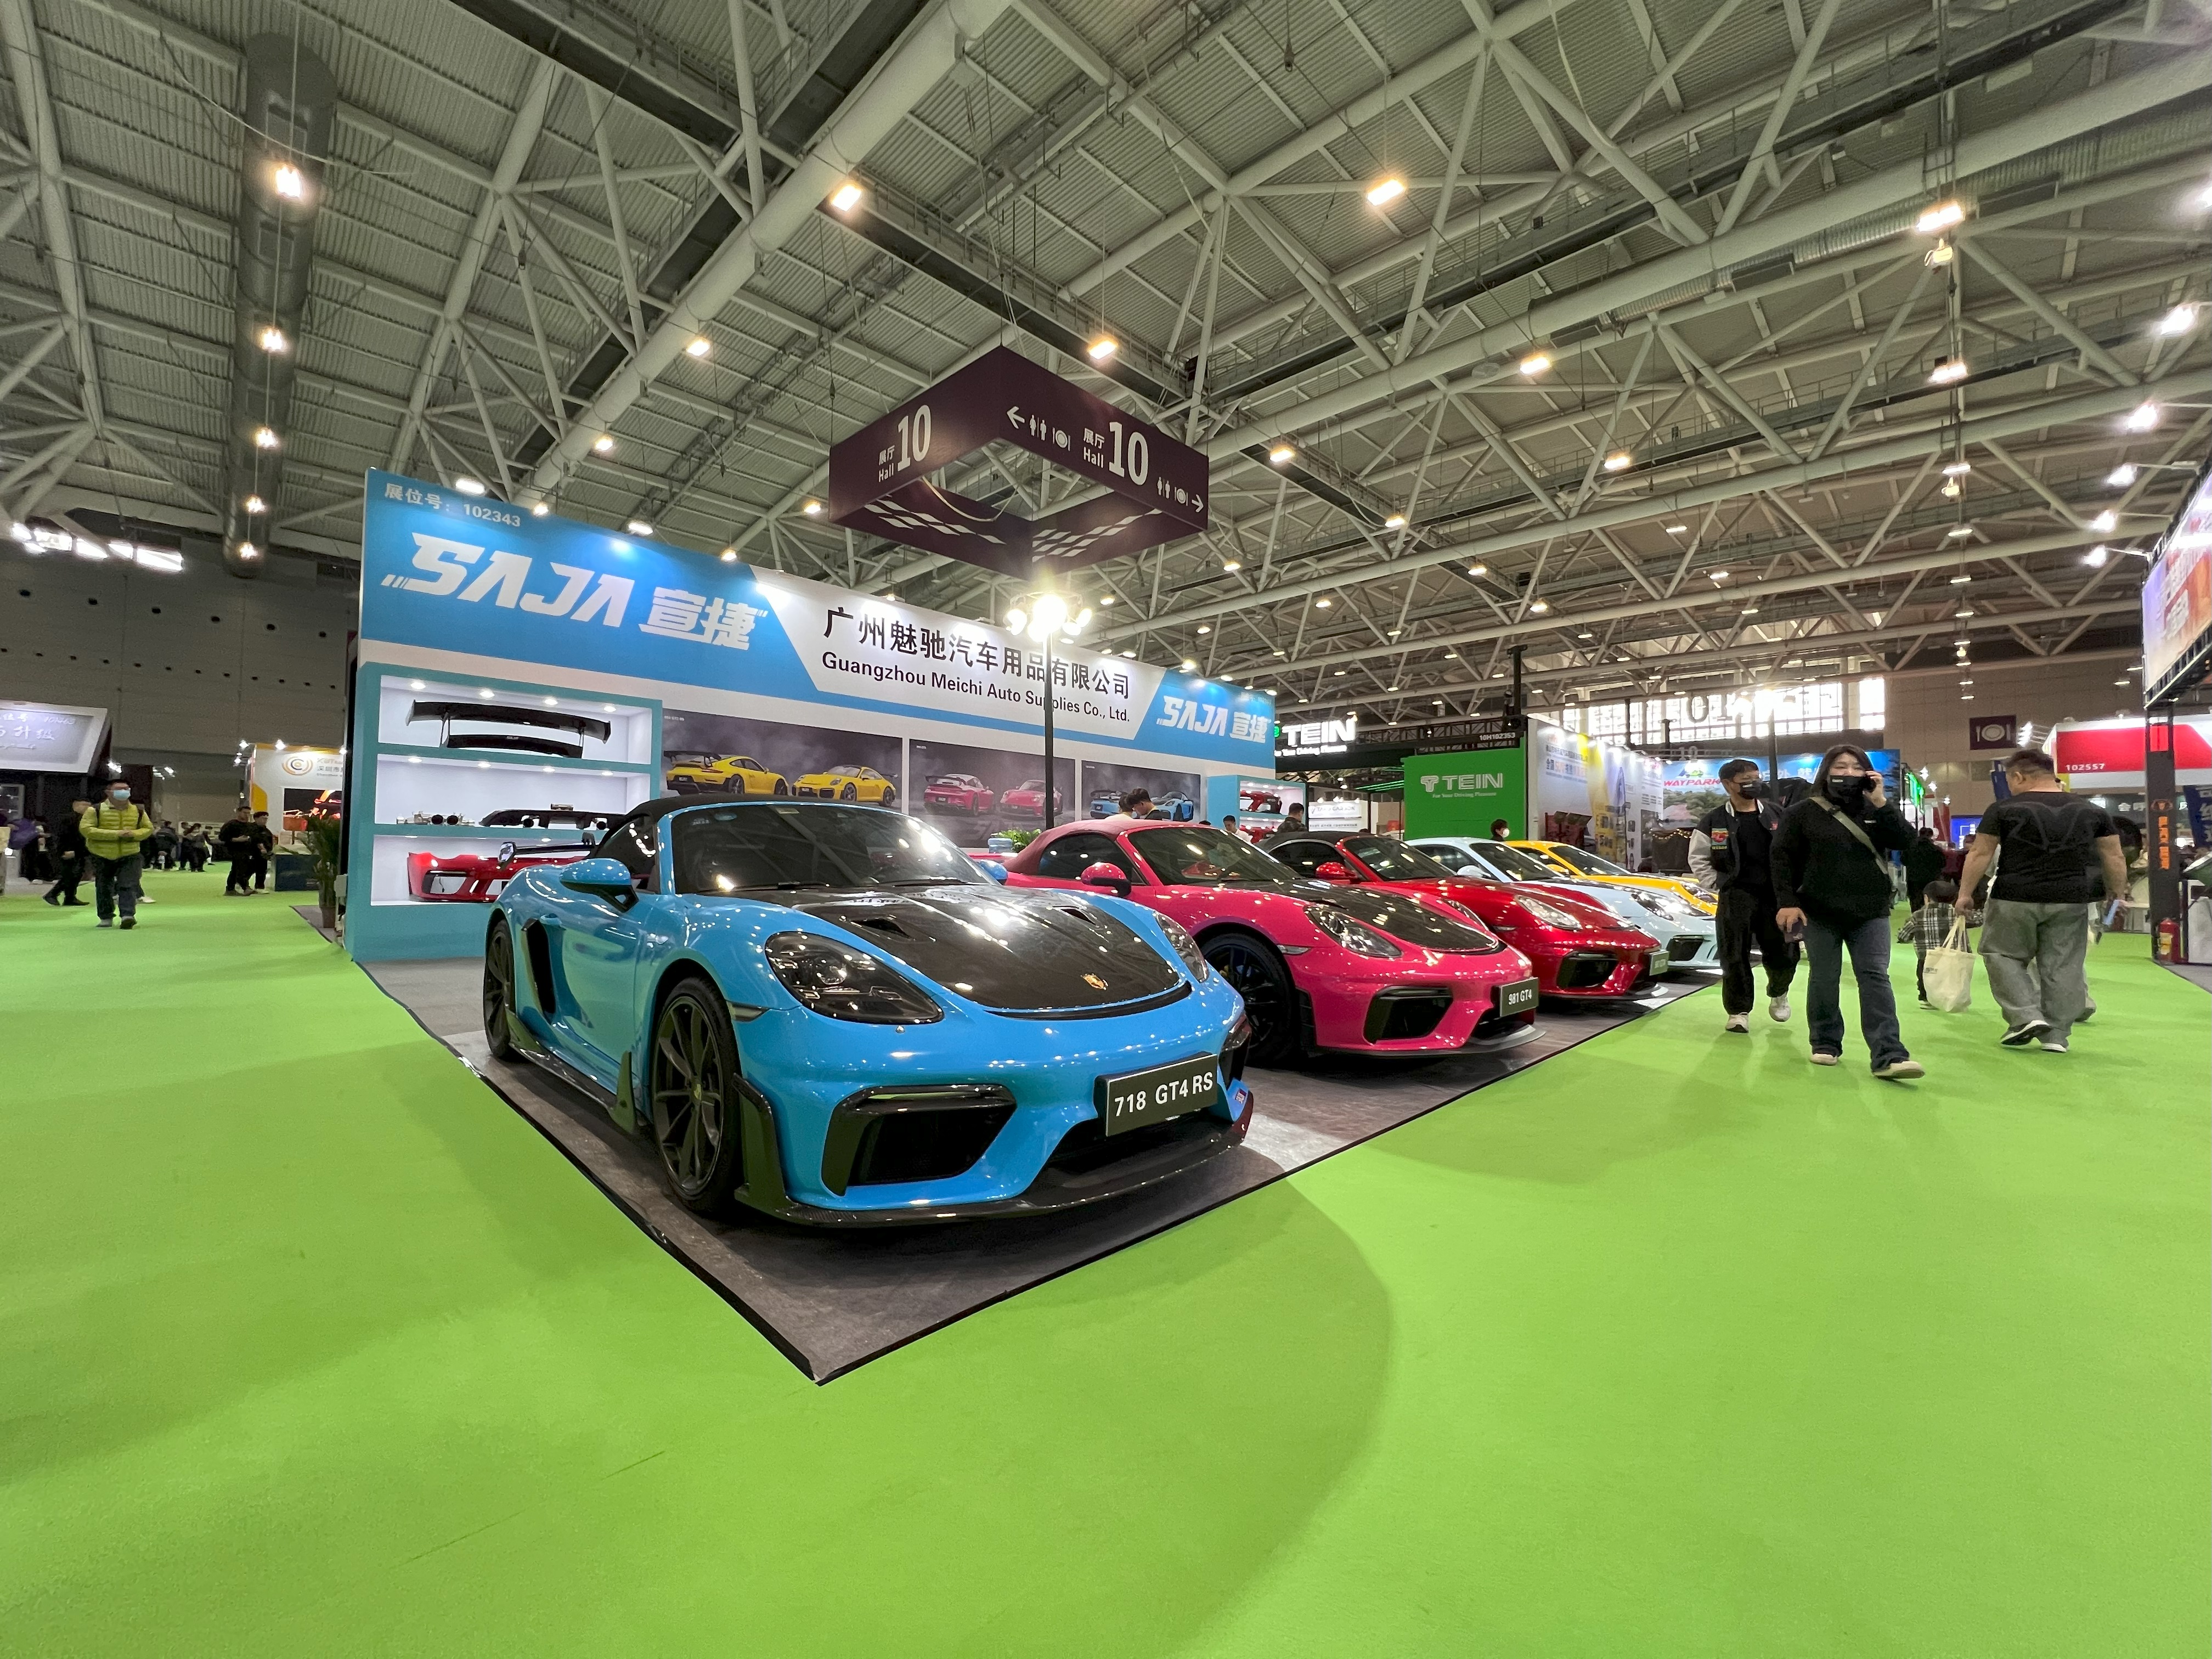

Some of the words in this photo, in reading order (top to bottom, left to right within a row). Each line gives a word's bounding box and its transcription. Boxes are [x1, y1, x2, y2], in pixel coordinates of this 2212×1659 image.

[898, 405, 931, 471] 10
[1084, 428, 1104, 449] 展厅
[879, 445, 895, 465] 展厅
[1084, 447, 1104, 468] Hall
[1109, 422, 1148, 485] 10
[879, 463, 894, 482] Hall
[464, 504, 521, 527] 102343
[382, 533, 635, 627] SAJA
[638, 586, 760, 651] 宣捷
[823, 607, 1128, 699] 广州魅驰汽车用品有限公司
[822, 651, 926, 686] Guangzhou
[932, 672, 982, 696] Meichi
[987, 683, 1021, 702] Auto
[1025, 690, 1080, 713] Suplies
[1084, 701, 1105, 719] Co.,
[1109, 706, 1130, 722] Ltd.
[1156, 695, 1228, 737] SAJA
[1229, 712, 1271, 743] 宣捷
[1282, 719, 1356, 746] TEIN
[2065, 763, 2105, 771] 102557
[1442, 773, 1503, 790] TEIN
[1520, 989, 1532, 1002] GT4
[1114, 1091, 1147, 1117] 718
[1155, 1079, 1189, 1105] GT4
[1192, 1071, 1214, 1095] RS
